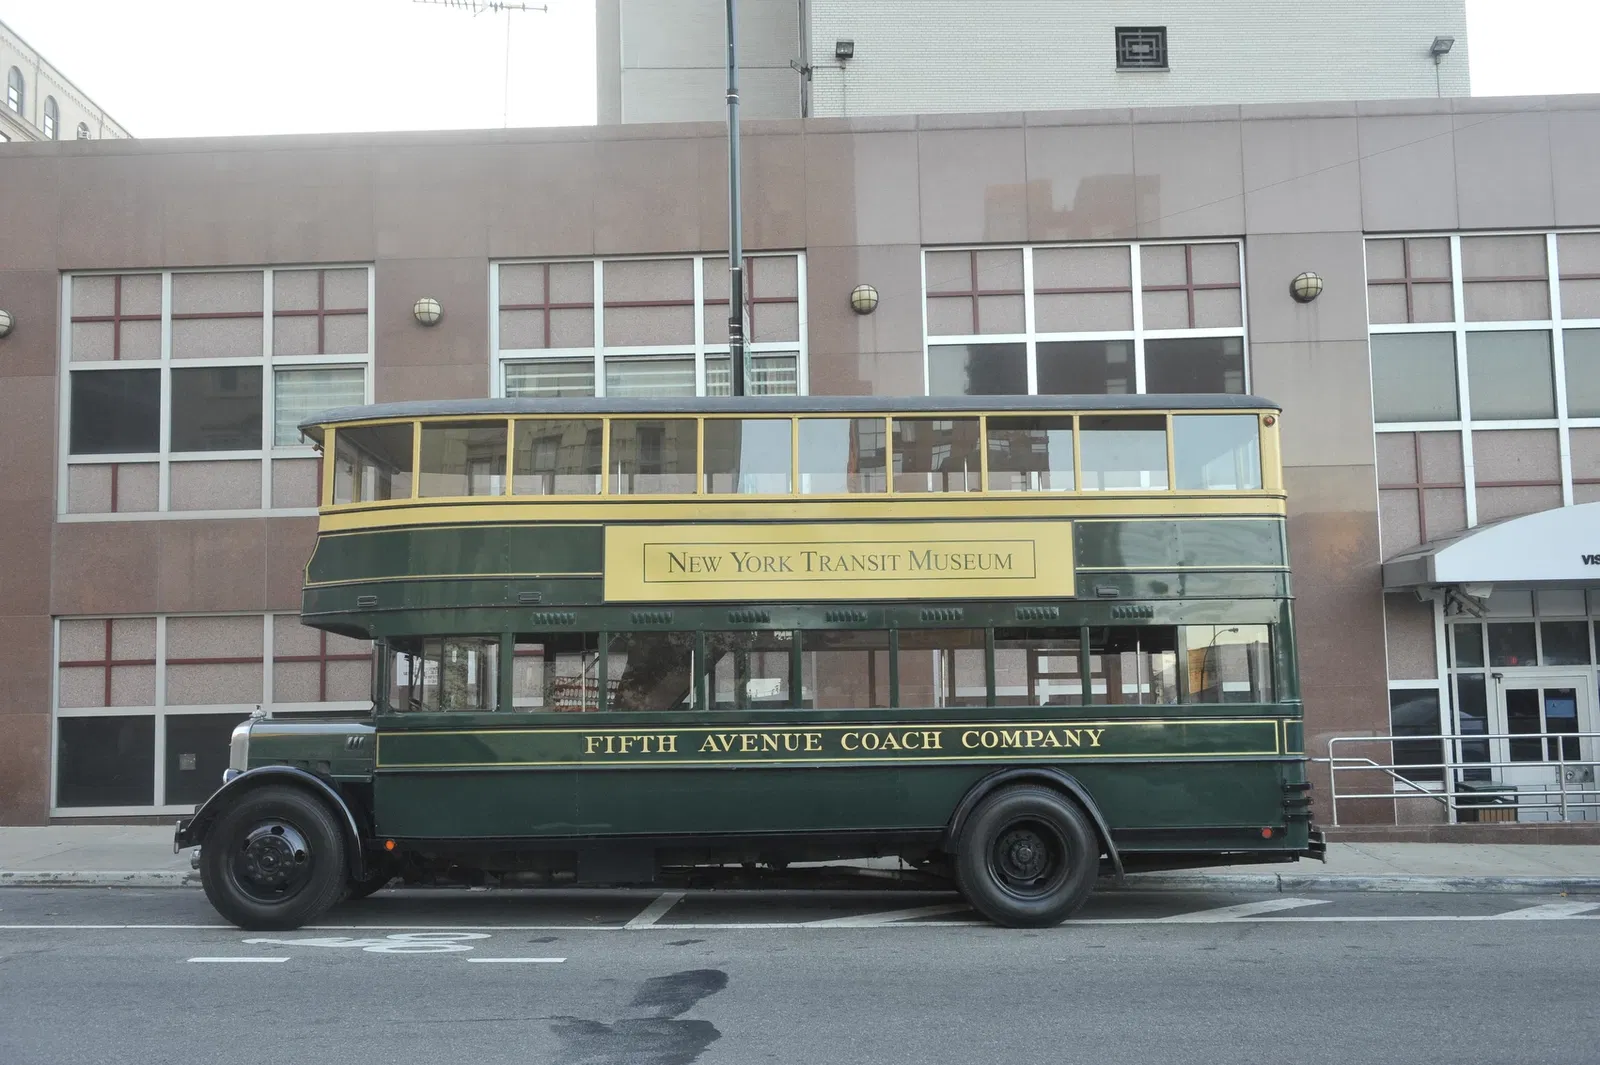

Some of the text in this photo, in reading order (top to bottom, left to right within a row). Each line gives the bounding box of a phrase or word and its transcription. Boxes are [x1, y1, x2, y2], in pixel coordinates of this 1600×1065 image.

[584, 728, 1105, 754] FIFTH AVENUE COACH COMPANY
